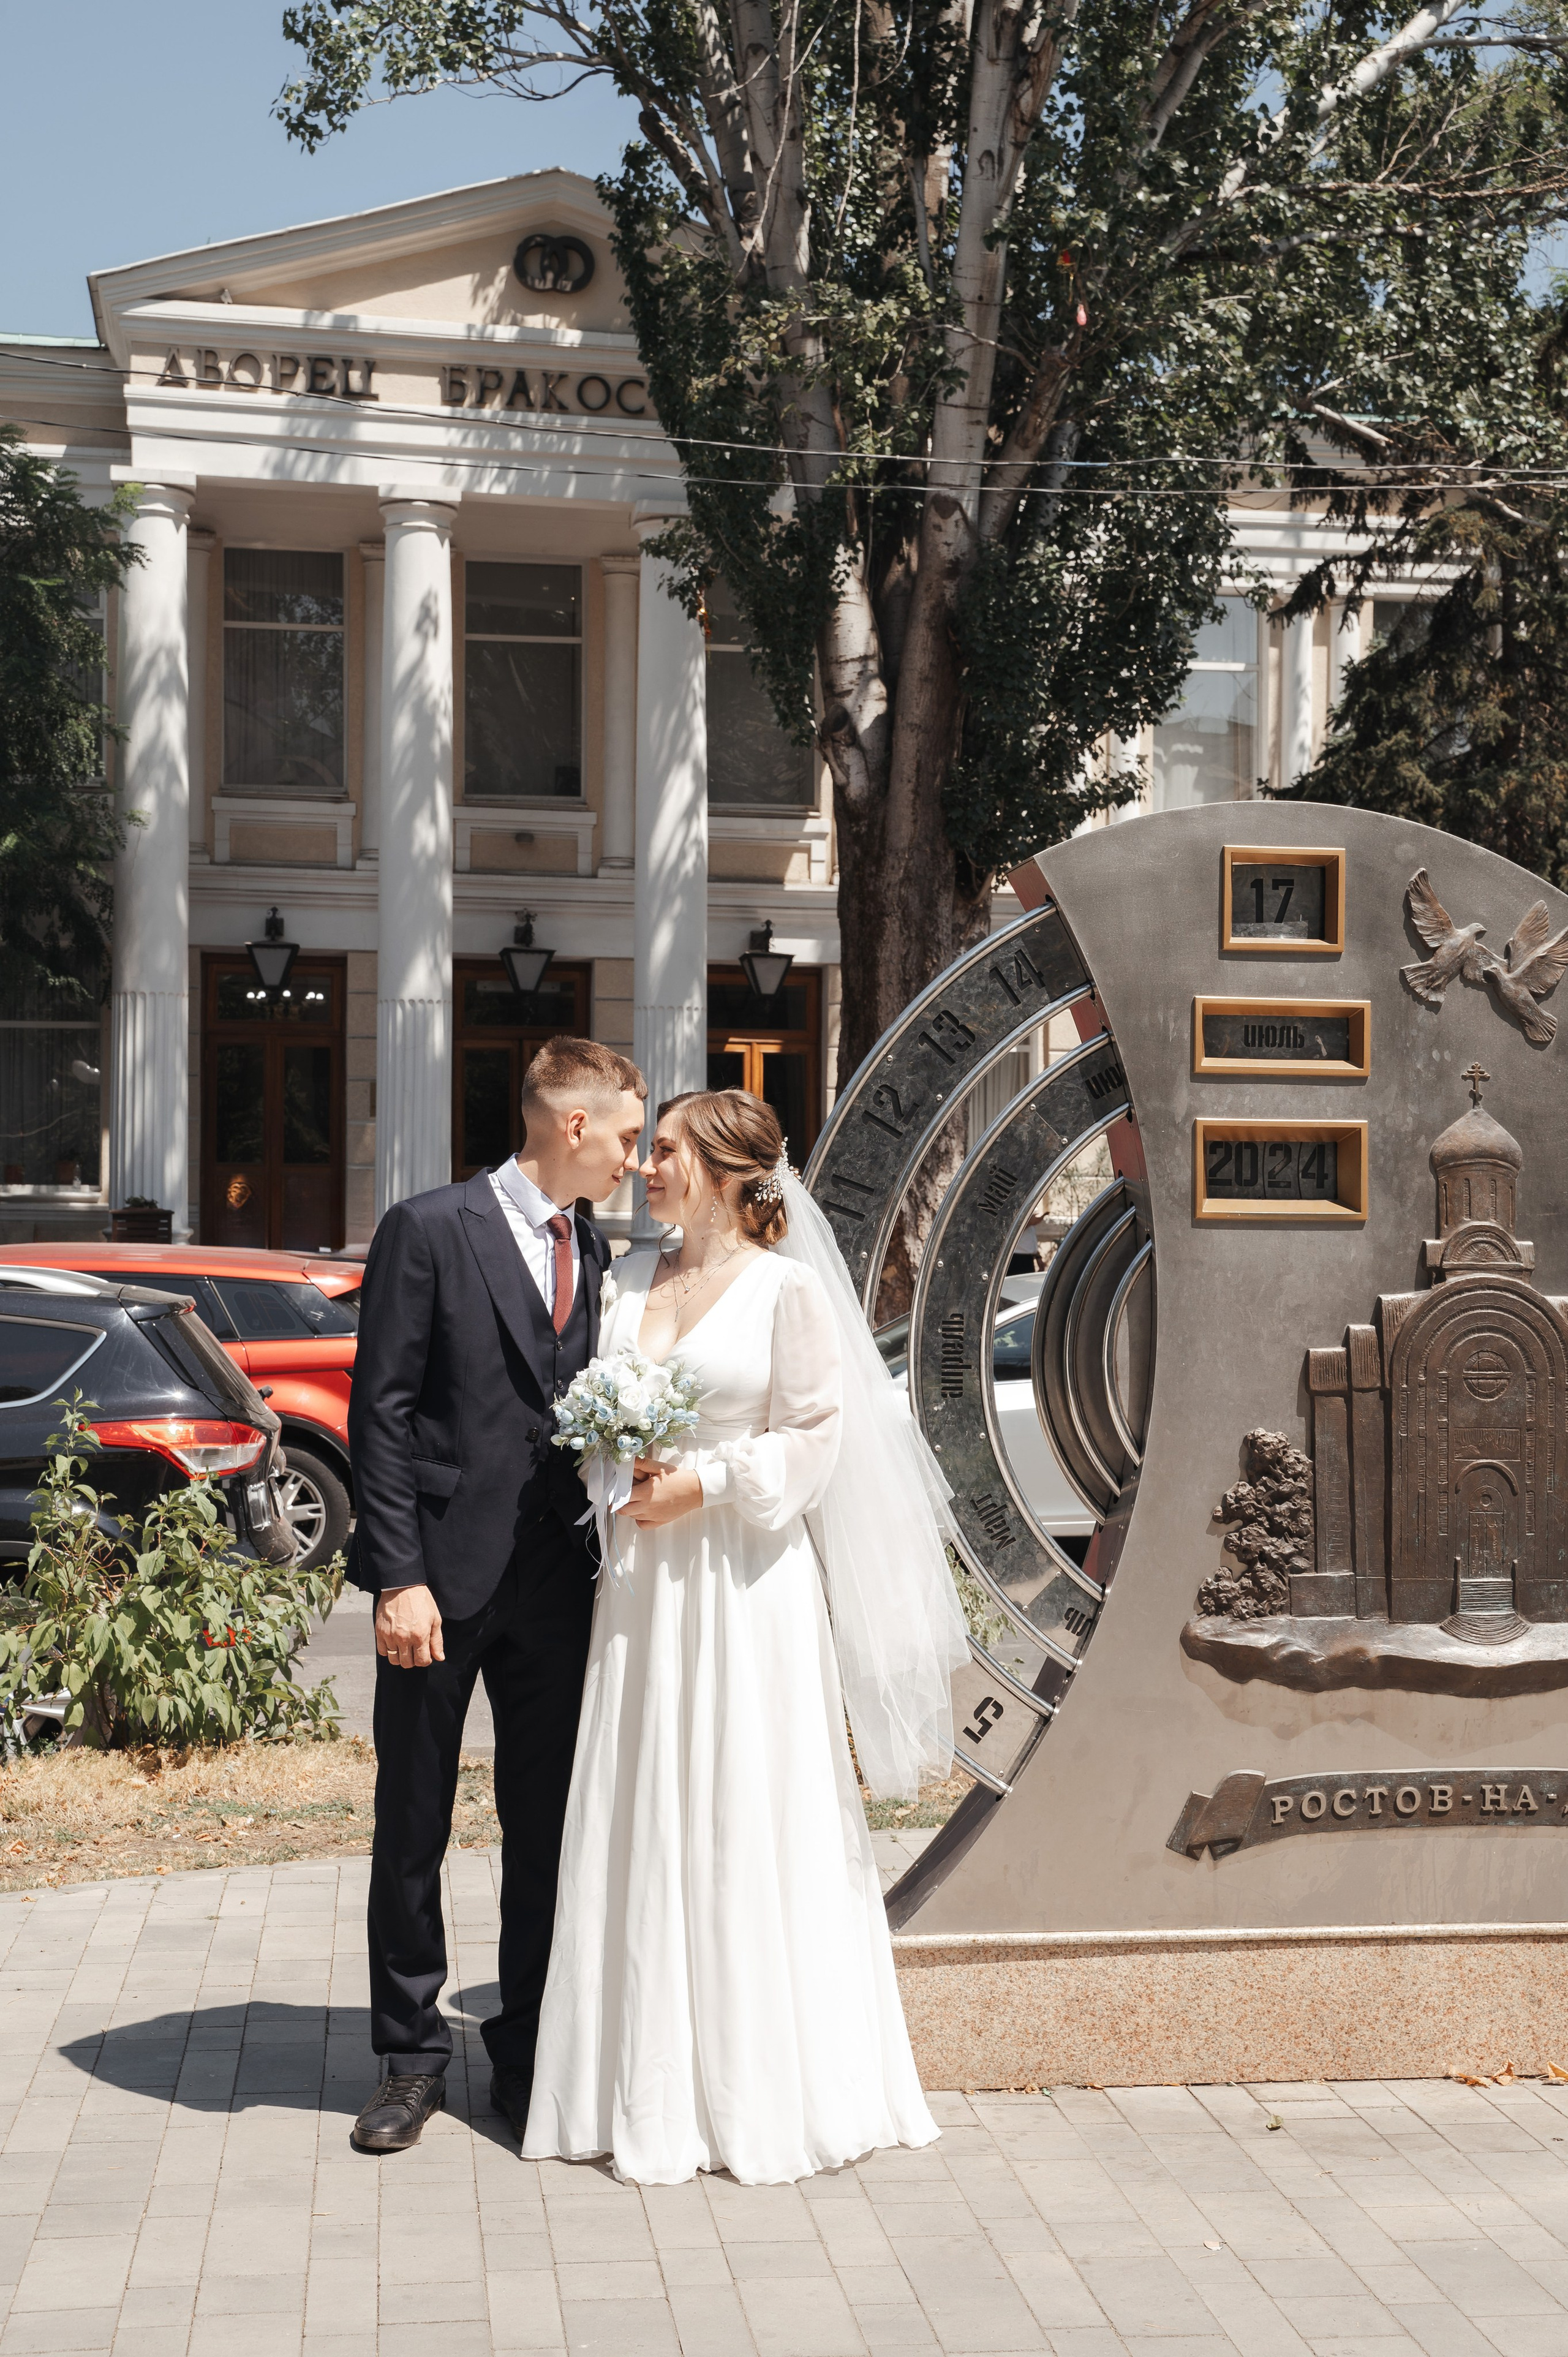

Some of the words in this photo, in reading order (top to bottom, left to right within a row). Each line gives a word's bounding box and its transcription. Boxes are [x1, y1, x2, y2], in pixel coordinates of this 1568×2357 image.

[155, 346, 379, 401] ДВОРЕЦ
[1250, 878, 1295, 924] 17
[823, 1173, 876, 1223] 11
[861, 1083, 919, 1140] 12
[919, 1009, 976, 1068] 13
[989, 949, 1046, 1008] 14
[1208, 1141, 1329, 1190] 2024
[941, 1313, 972, 1399] апрель
[962, 1695, 1005, 1744] 5
[1270, 1784, 1568, 1825] РОСТОВ-НА-
